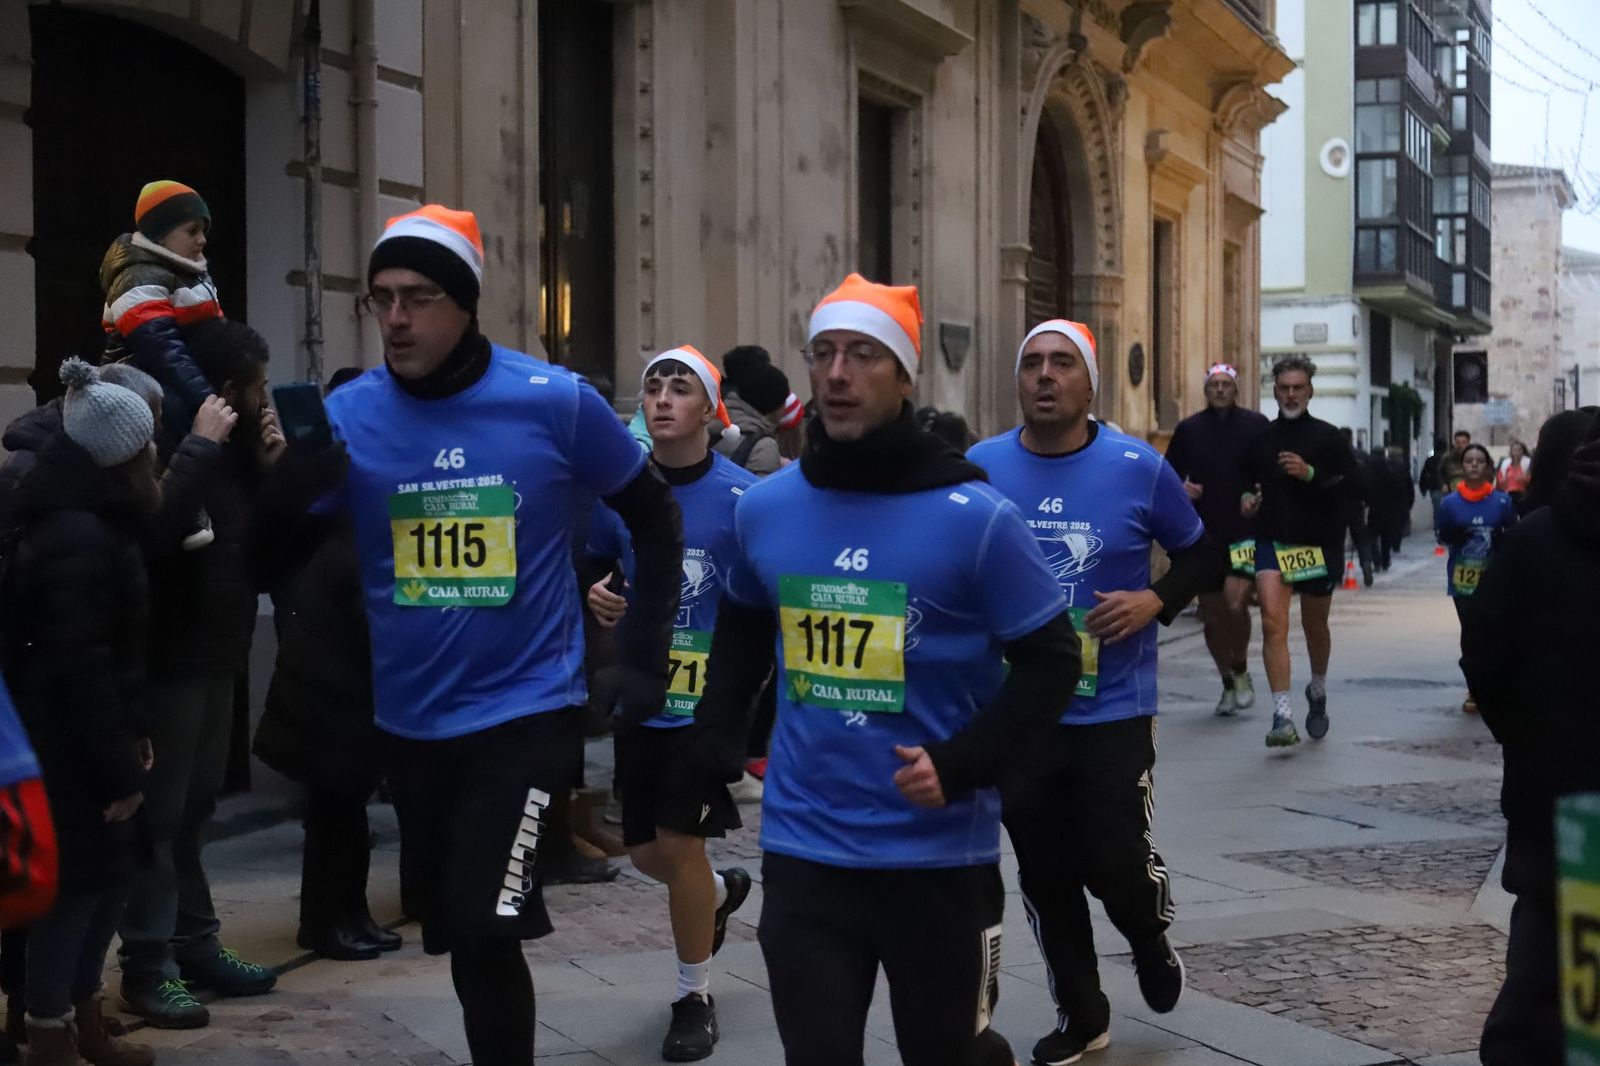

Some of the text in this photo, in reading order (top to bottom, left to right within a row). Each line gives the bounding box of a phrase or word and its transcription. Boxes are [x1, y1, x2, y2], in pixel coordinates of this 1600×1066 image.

[433, 447, 466, 470] 46
[398, 473, 504, 493] SAN SILVESTRE 2025
[449, 501, 479, 511] RURAL
[1037, 497, 1063, 514] 46
[1071, 521, 1090, 530] 2025
[409, 522, 487, 568] 1115
[686, 549, 705, 557] 2025
[833, 547, 869, 571] 46
[1280, 549, 1317, 572] 1263
[427, 585, 509, 598] CAJA RURAL
[835, 594, 868, 606] RURAL
[797, 613, 874, 669] 1117
[811, 683, 897, 703] CAJA RURAL
[674, 699, 697, 710] RUR
